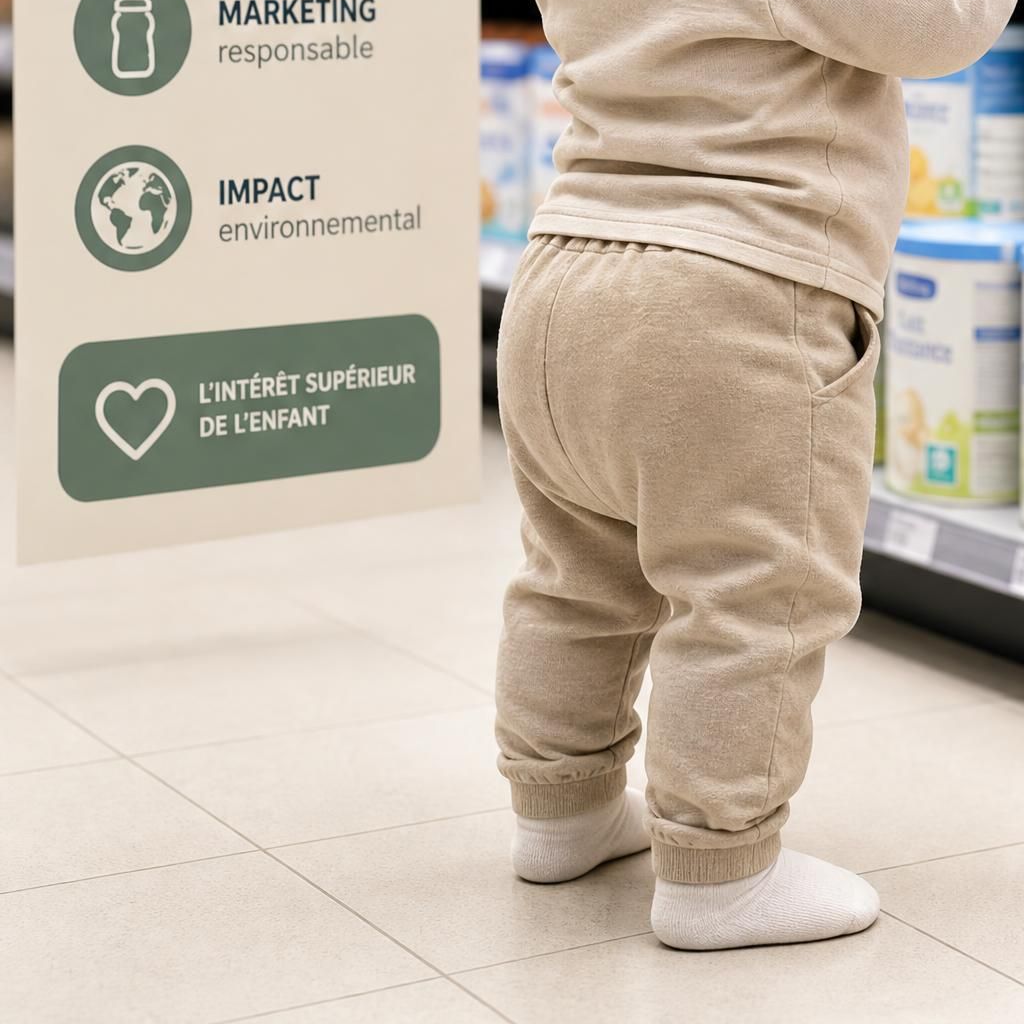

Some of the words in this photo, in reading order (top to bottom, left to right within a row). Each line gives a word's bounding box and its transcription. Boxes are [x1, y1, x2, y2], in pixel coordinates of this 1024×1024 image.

[218, 34, 375, 68] responsable
[218, 174, 321, 206] IMPACT
[218, 205, 422, 242] environnemental
[305, 363, 417, 394] SUPÉRIEUR
[199, 416, 228, 438] DE
[234, 404, 330, 434] L'ENFANT
